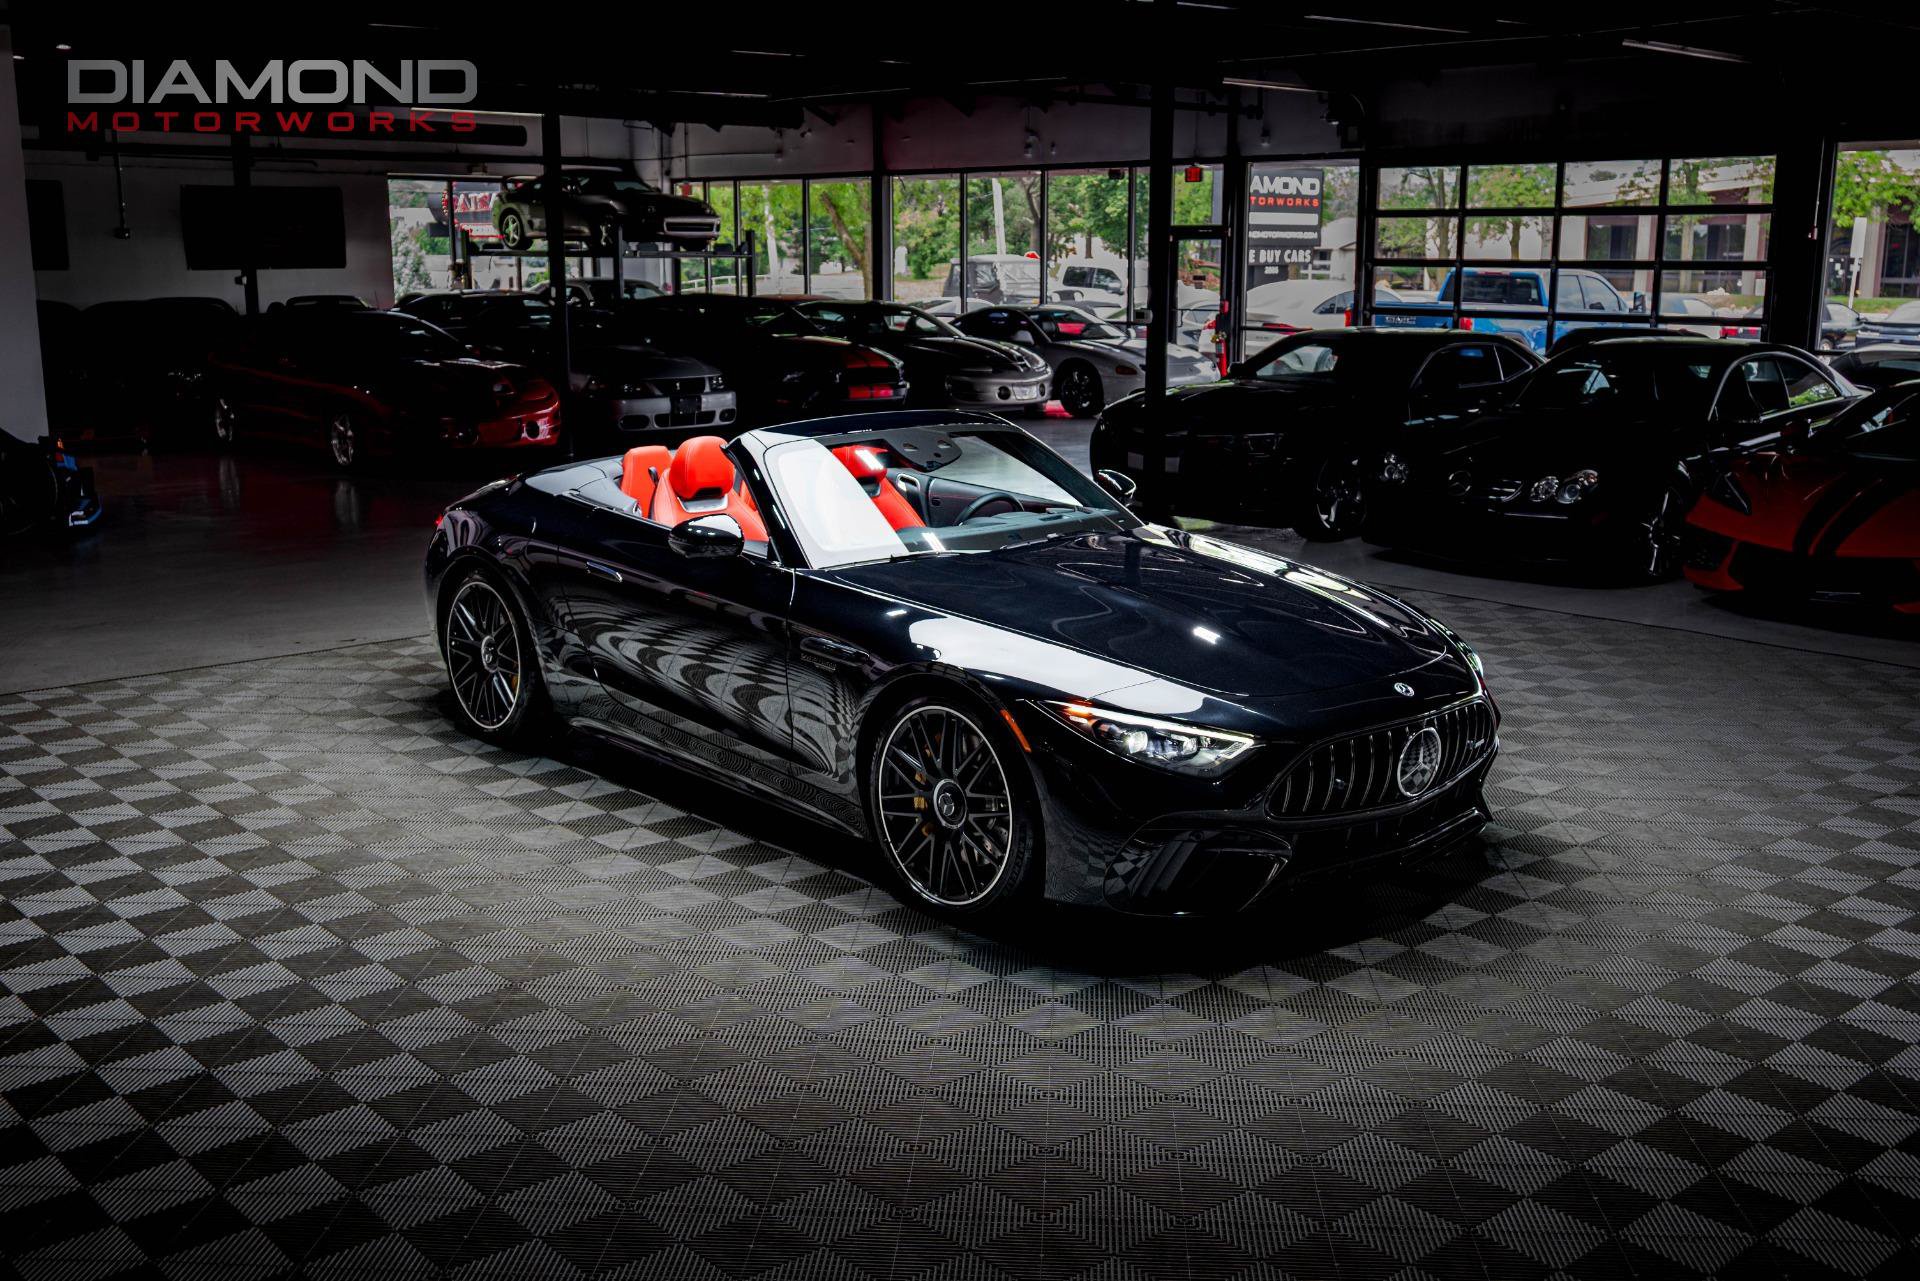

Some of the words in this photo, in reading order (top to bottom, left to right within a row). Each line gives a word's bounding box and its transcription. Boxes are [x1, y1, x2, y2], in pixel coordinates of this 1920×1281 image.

[1250, 176, 1320, 195] AMOND
[1250, 196, 1319, 207] TORWORKS
[1260, 250, 1281, 263] BUY
[1284, 250, 1311, 263] CARS
